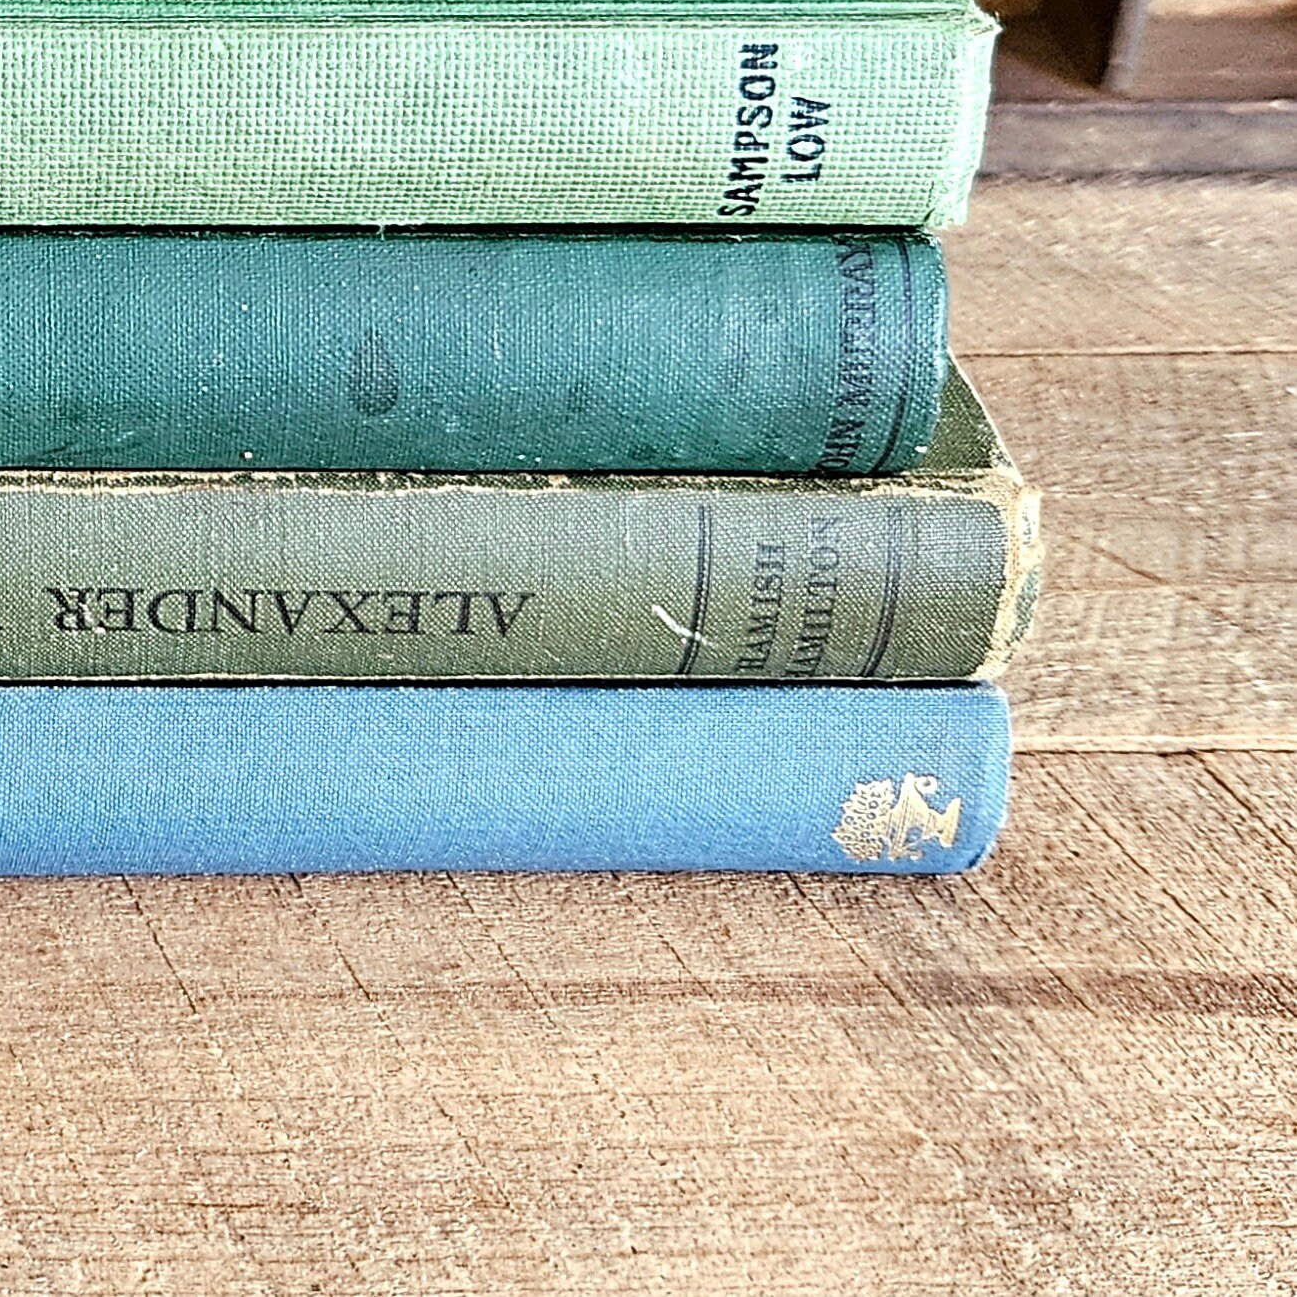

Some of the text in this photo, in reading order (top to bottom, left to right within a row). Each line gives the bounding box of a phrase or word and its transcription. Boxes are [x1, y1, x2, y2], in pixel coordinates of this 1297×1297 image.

[717, 43, 779, 216] SAMPSON
[780, 97, 831, 182] LOW
[816, 419, 866, 470] OHN
[45, 587, 536, 637] ALEXANDER
[735, 541, 785, 670] HAMISH
